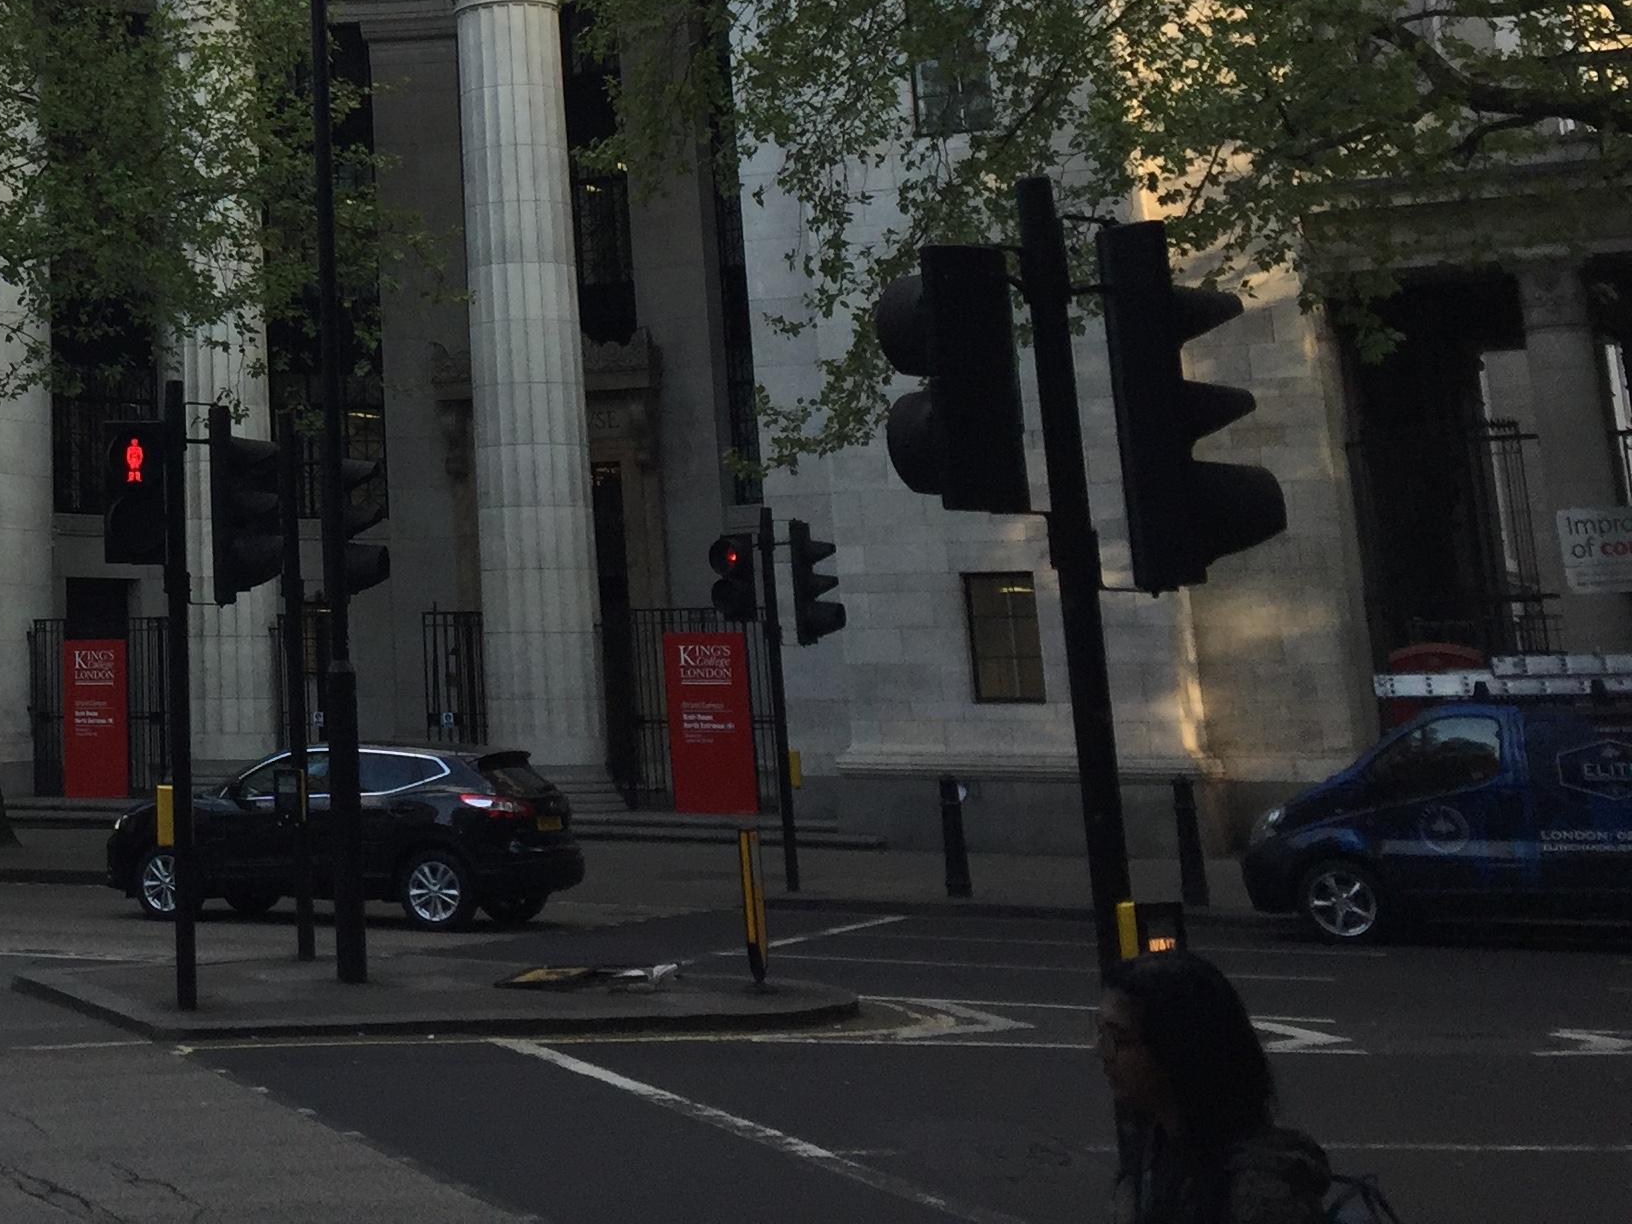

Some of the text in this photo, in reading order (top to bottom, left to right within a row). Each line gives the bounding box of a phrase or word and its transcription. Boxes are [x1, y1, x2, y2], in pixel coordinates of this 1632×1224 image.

[1571, 536, 1594, 558] of
[74, 669, 115, 680] LONDON
[679, 667, 733, 679] LONDON
[1583, 762, 1632, 777] ELIT
